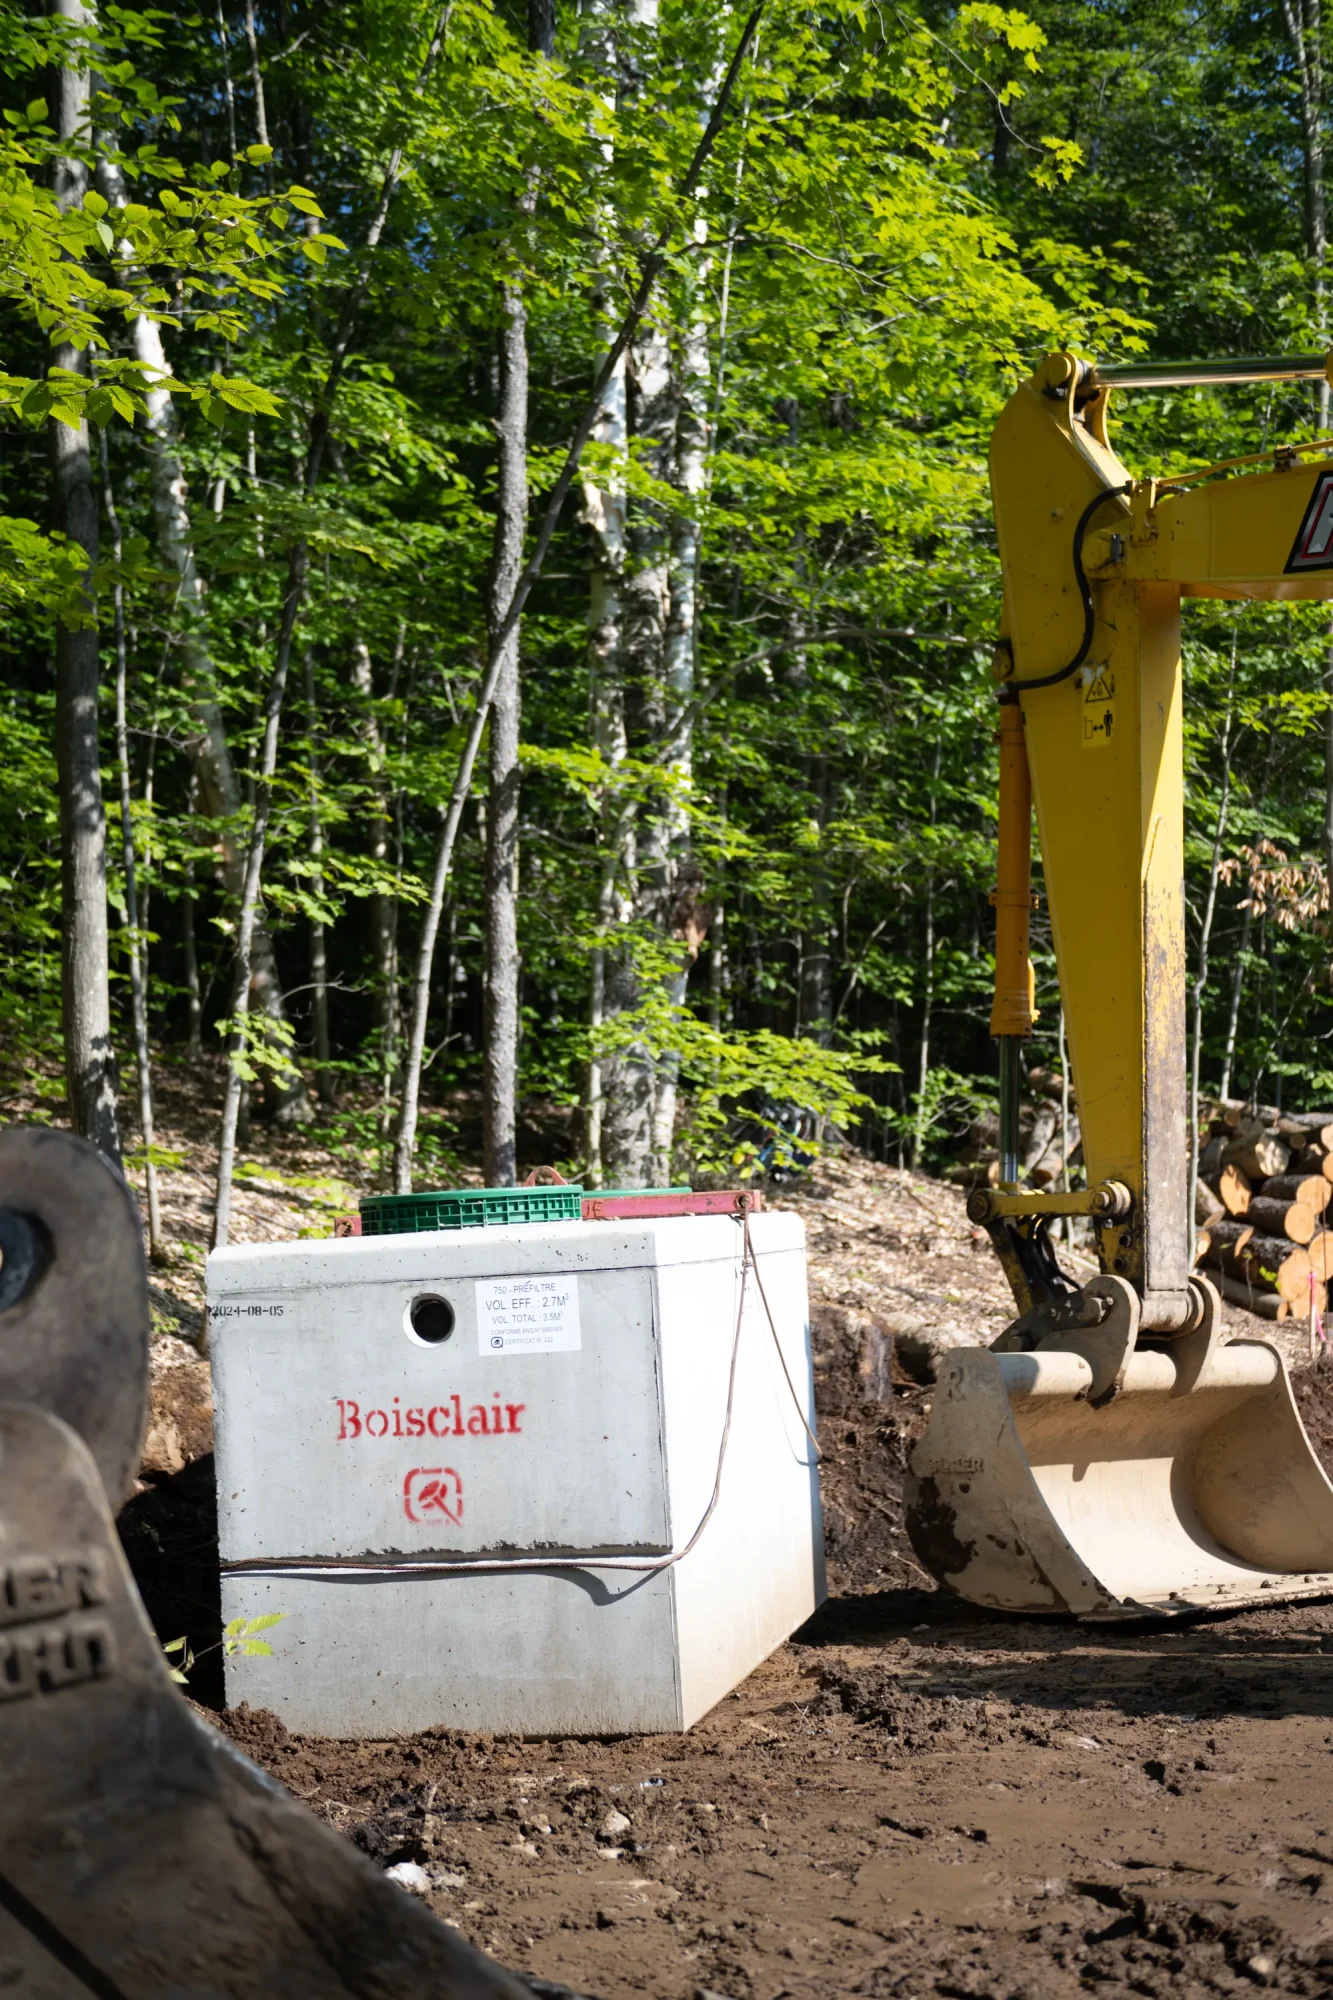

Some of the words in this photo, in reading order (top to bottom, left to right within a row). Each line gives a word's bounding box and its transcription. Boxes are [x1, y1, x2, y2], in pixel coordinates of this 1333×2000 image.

[493, 1286, 507, 1294] 750
[513, 1280, 556, 1294] PRÉFILTRE
[485, 1299, 510, 1311] VOL.
[511, 1297, 534, 1309] EFF.
[492, 1315, 510, 1324] VOL.
[511, 1313, 537, 1323] TOTAL
[490, 1327, 521, 1336] CONFORME
[505, 1337, 536, 1345] CERTIFICAT
[336, 1391, 526, 1440] Boisclair
